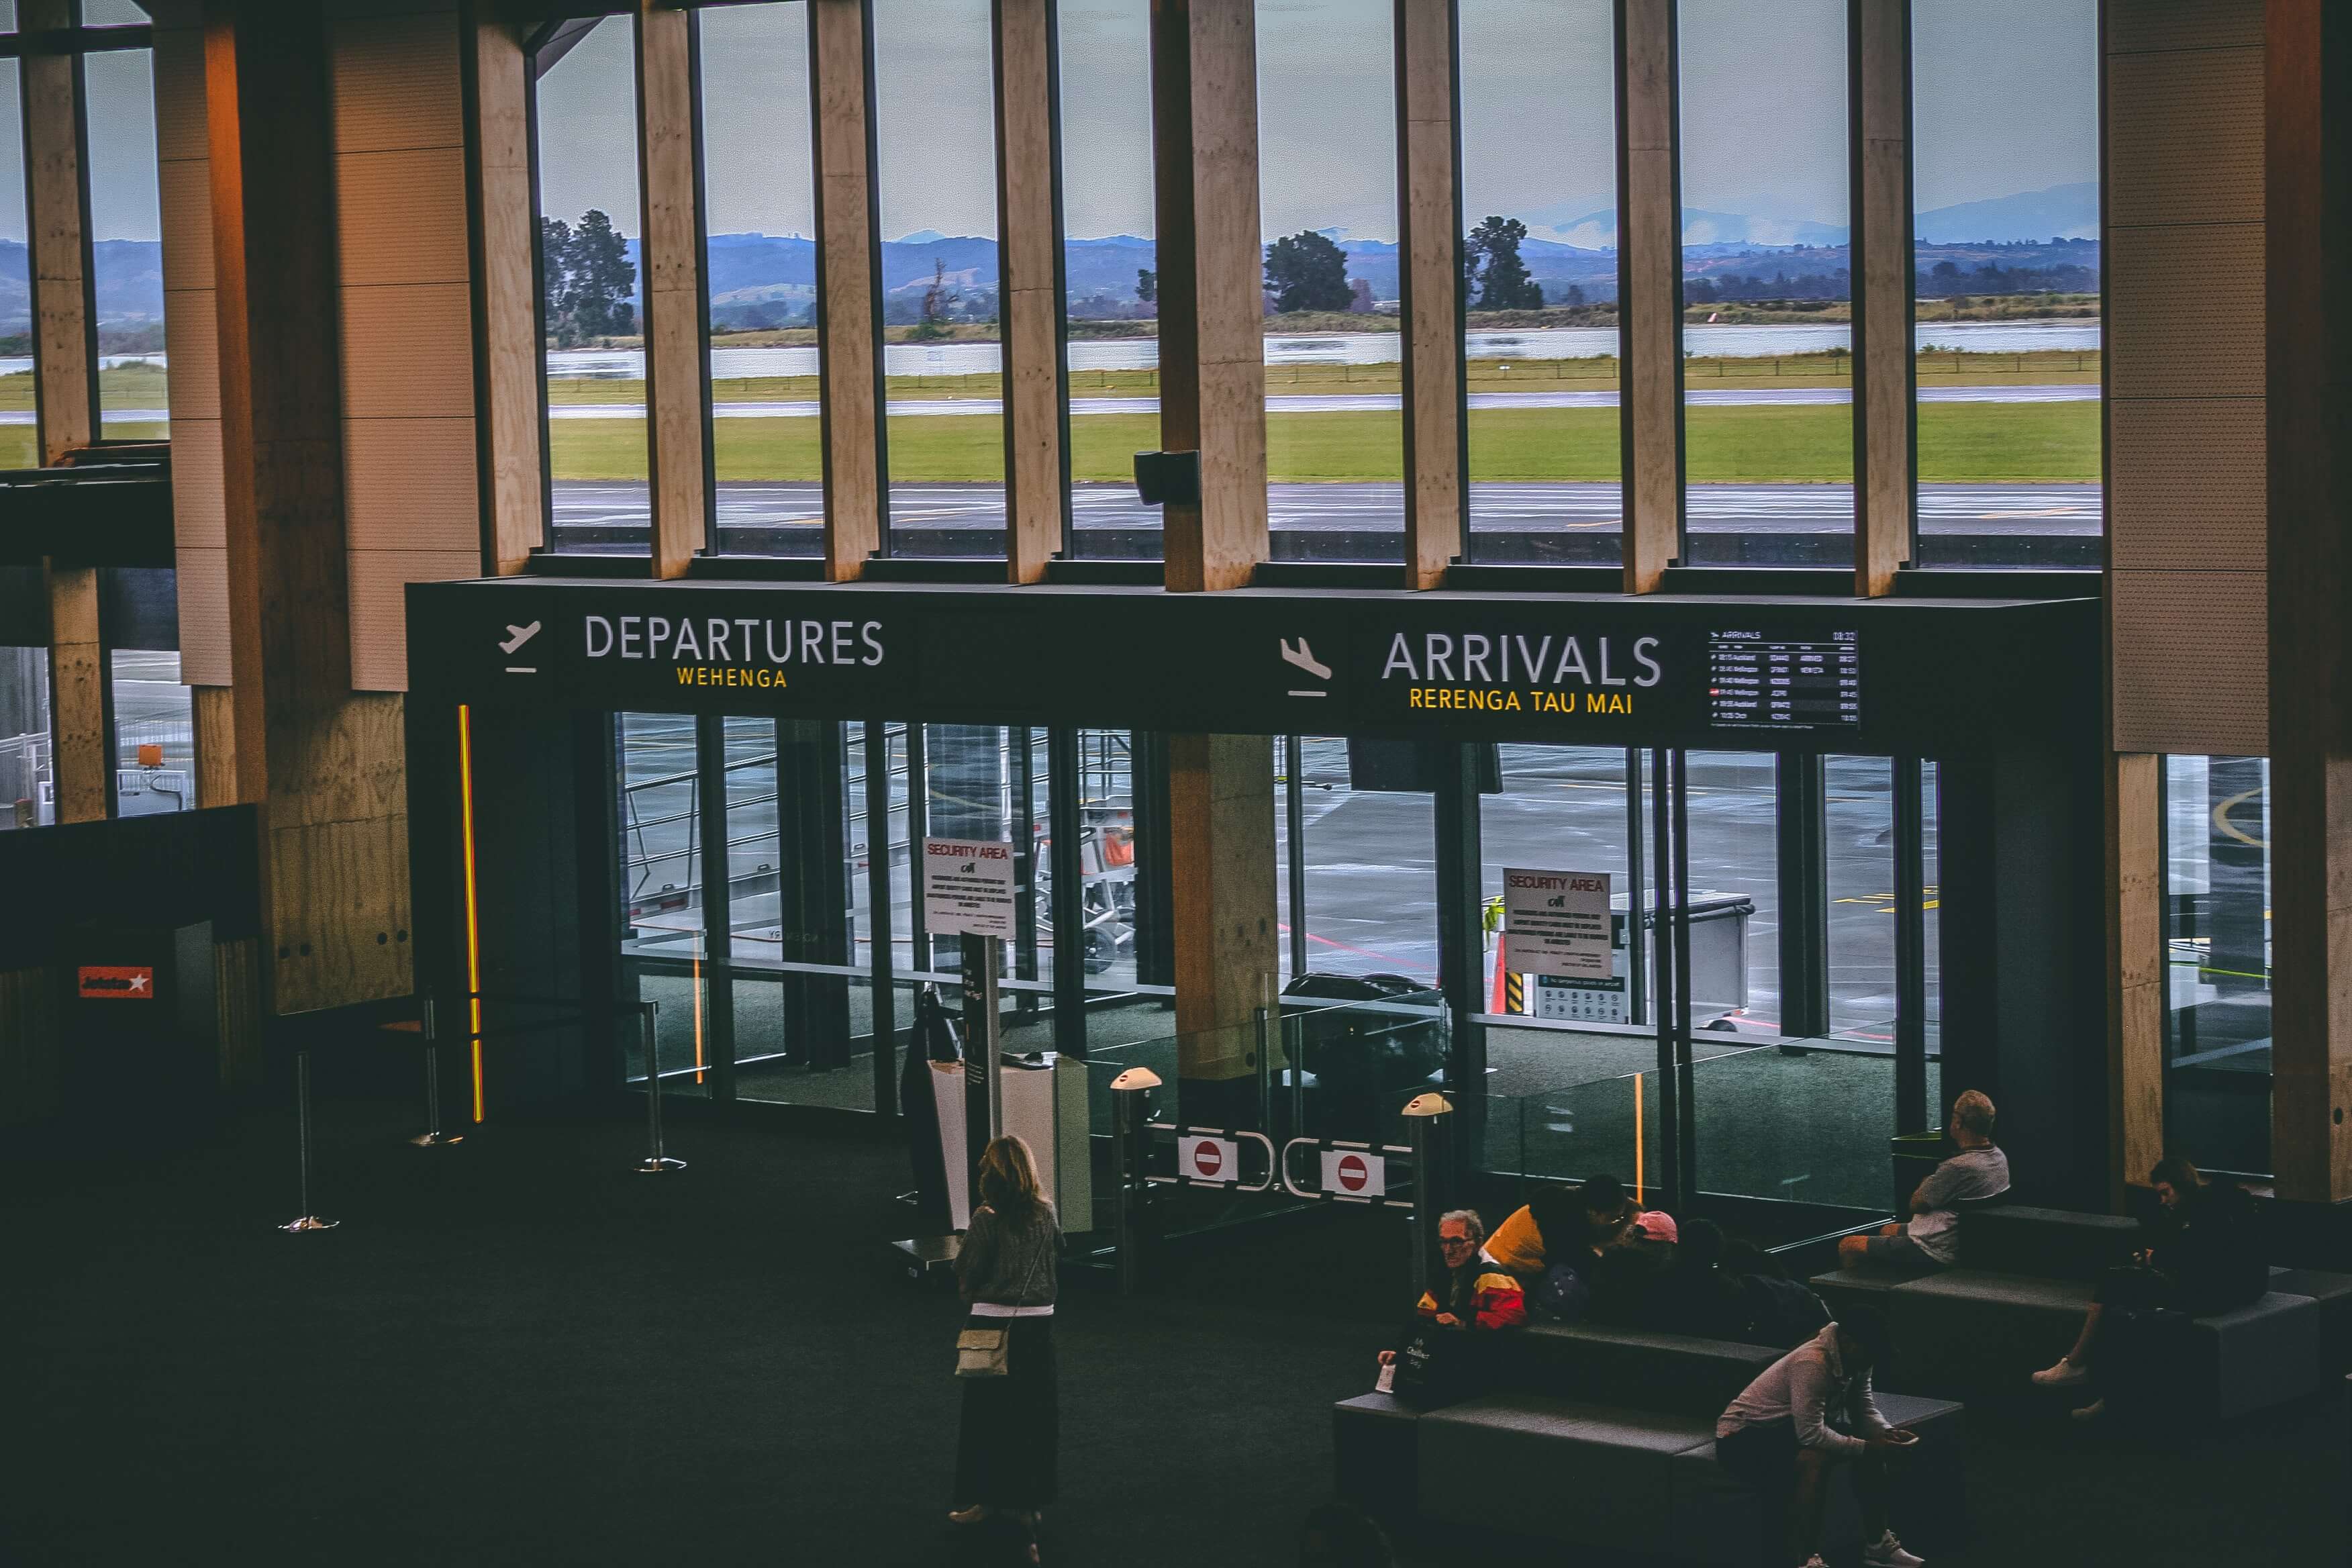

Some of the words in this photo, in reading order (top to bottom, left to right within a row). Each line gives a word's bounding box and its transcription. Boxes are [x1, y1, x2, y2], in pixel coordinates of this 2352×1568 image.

[585, 616, 884, 666] DEPARTURES
[1381, 632, 1661, 687] ARRIVALS
[677, 667, 787, 688] WEHENGA
[1410, 688, 1522, 712] RERENGA
[1530, 691, 1575, 713] TAU
[1587, 693, 1632, 714] MAI
[928, 843, 977, 856] SECURITY
[979, 846, 1008, 860] AREA
[1509, 875, 1568, 889] SECURITY
[1569, 878, 1605, 892] AREA
